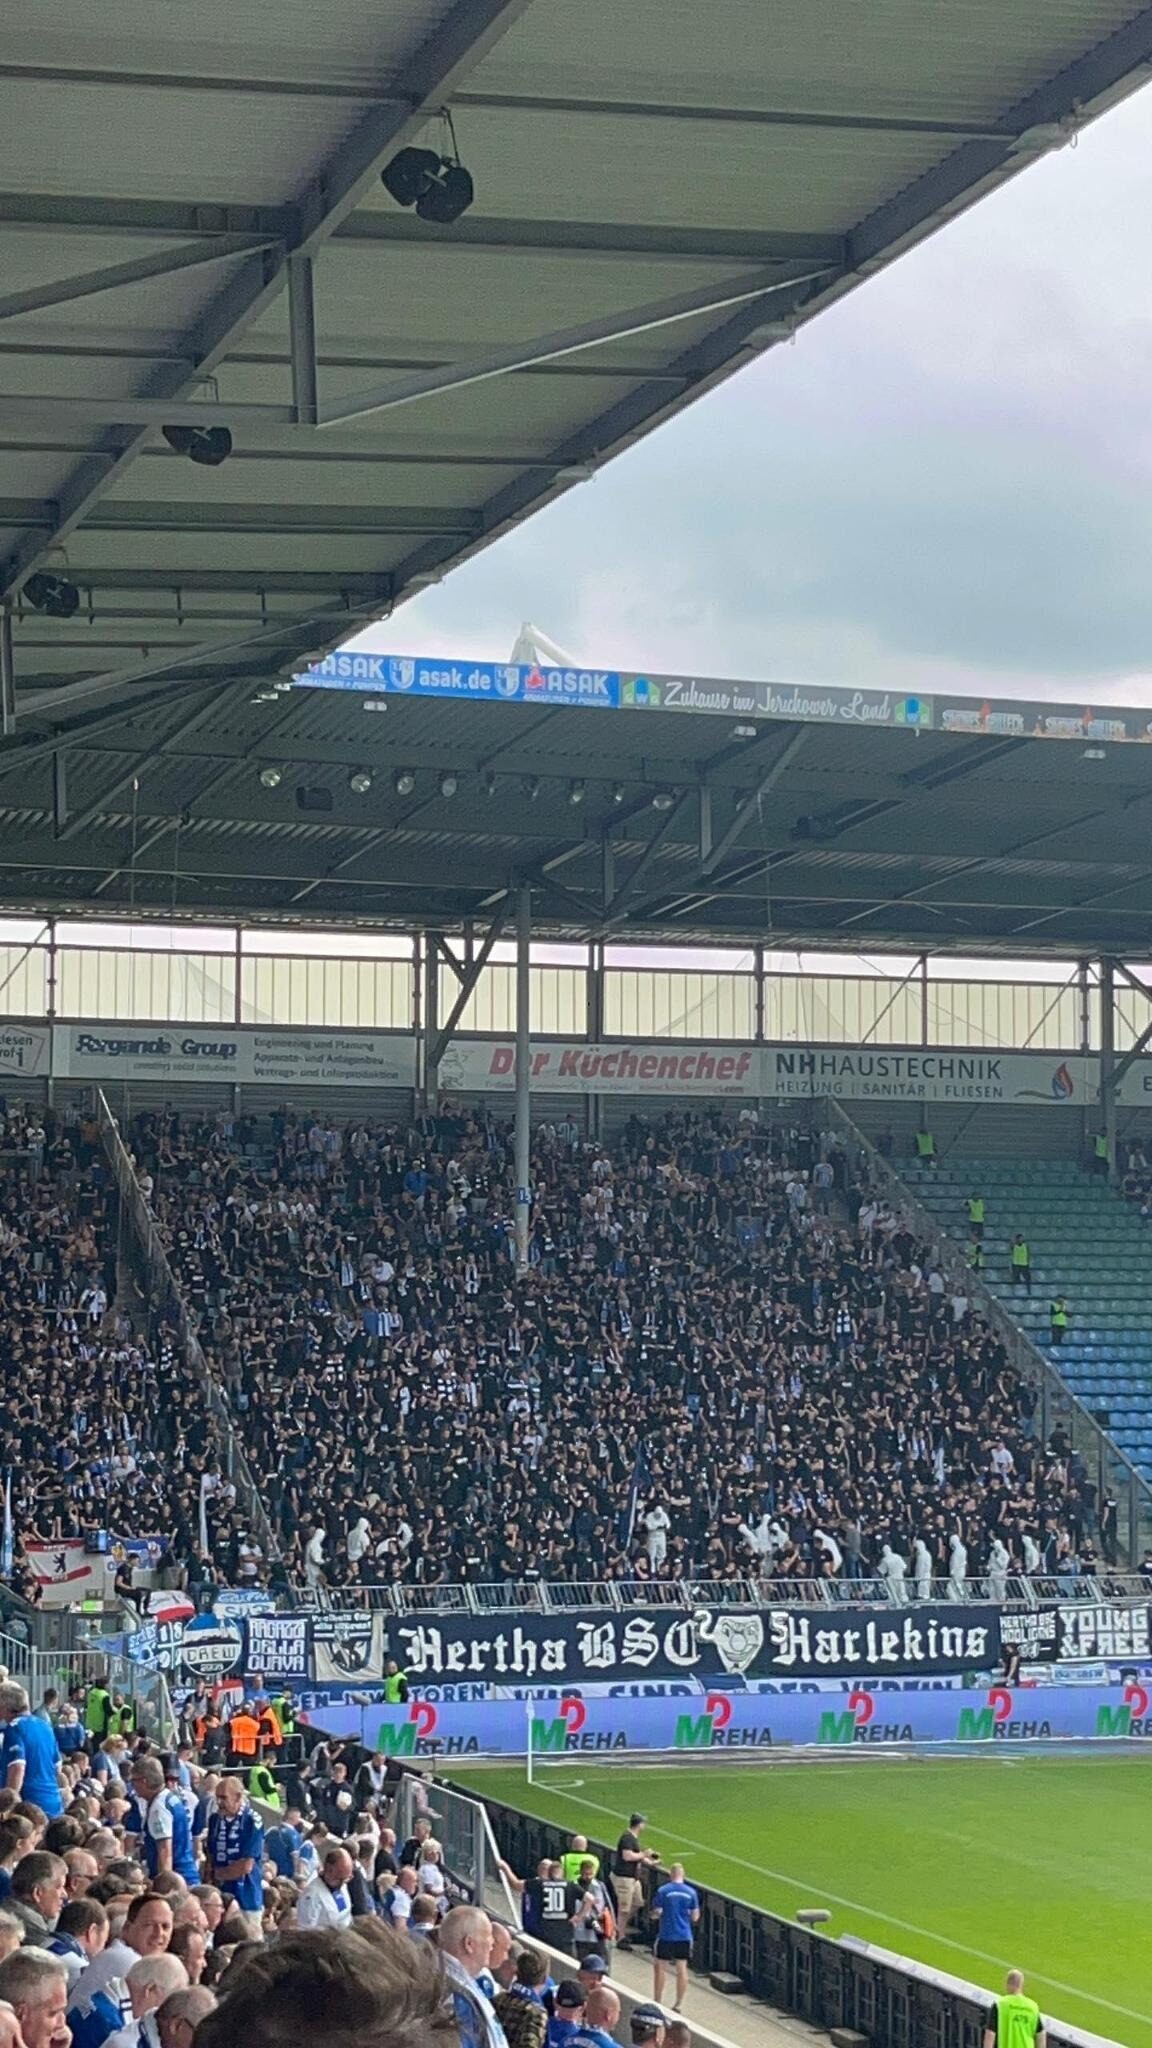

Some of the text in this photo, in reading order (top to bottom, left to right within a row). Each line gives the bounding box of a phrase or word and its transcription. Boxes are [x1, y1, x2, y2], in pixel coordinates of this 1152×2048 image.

[321, 655, 385, 678] ASAK
[419, 667, 491, 690] asak.de
[547, 671, 609, 695] ASAK
[664, 680, 891, 721] Zuhause im Jerichower Land
[181, 1039, 236, 1060] Group
[489, 1048, 752, 1080] Dr Küchenchef
[775, 1080, 1003, 1098] HEIZUNG SANITÄR FLIESEN
[1059, 1608, 1148, 1633] YOUNG
[398, 1612, 988, 1677] Hertha BSC Harlekins
[543, 1887, 565, 1912] 30
